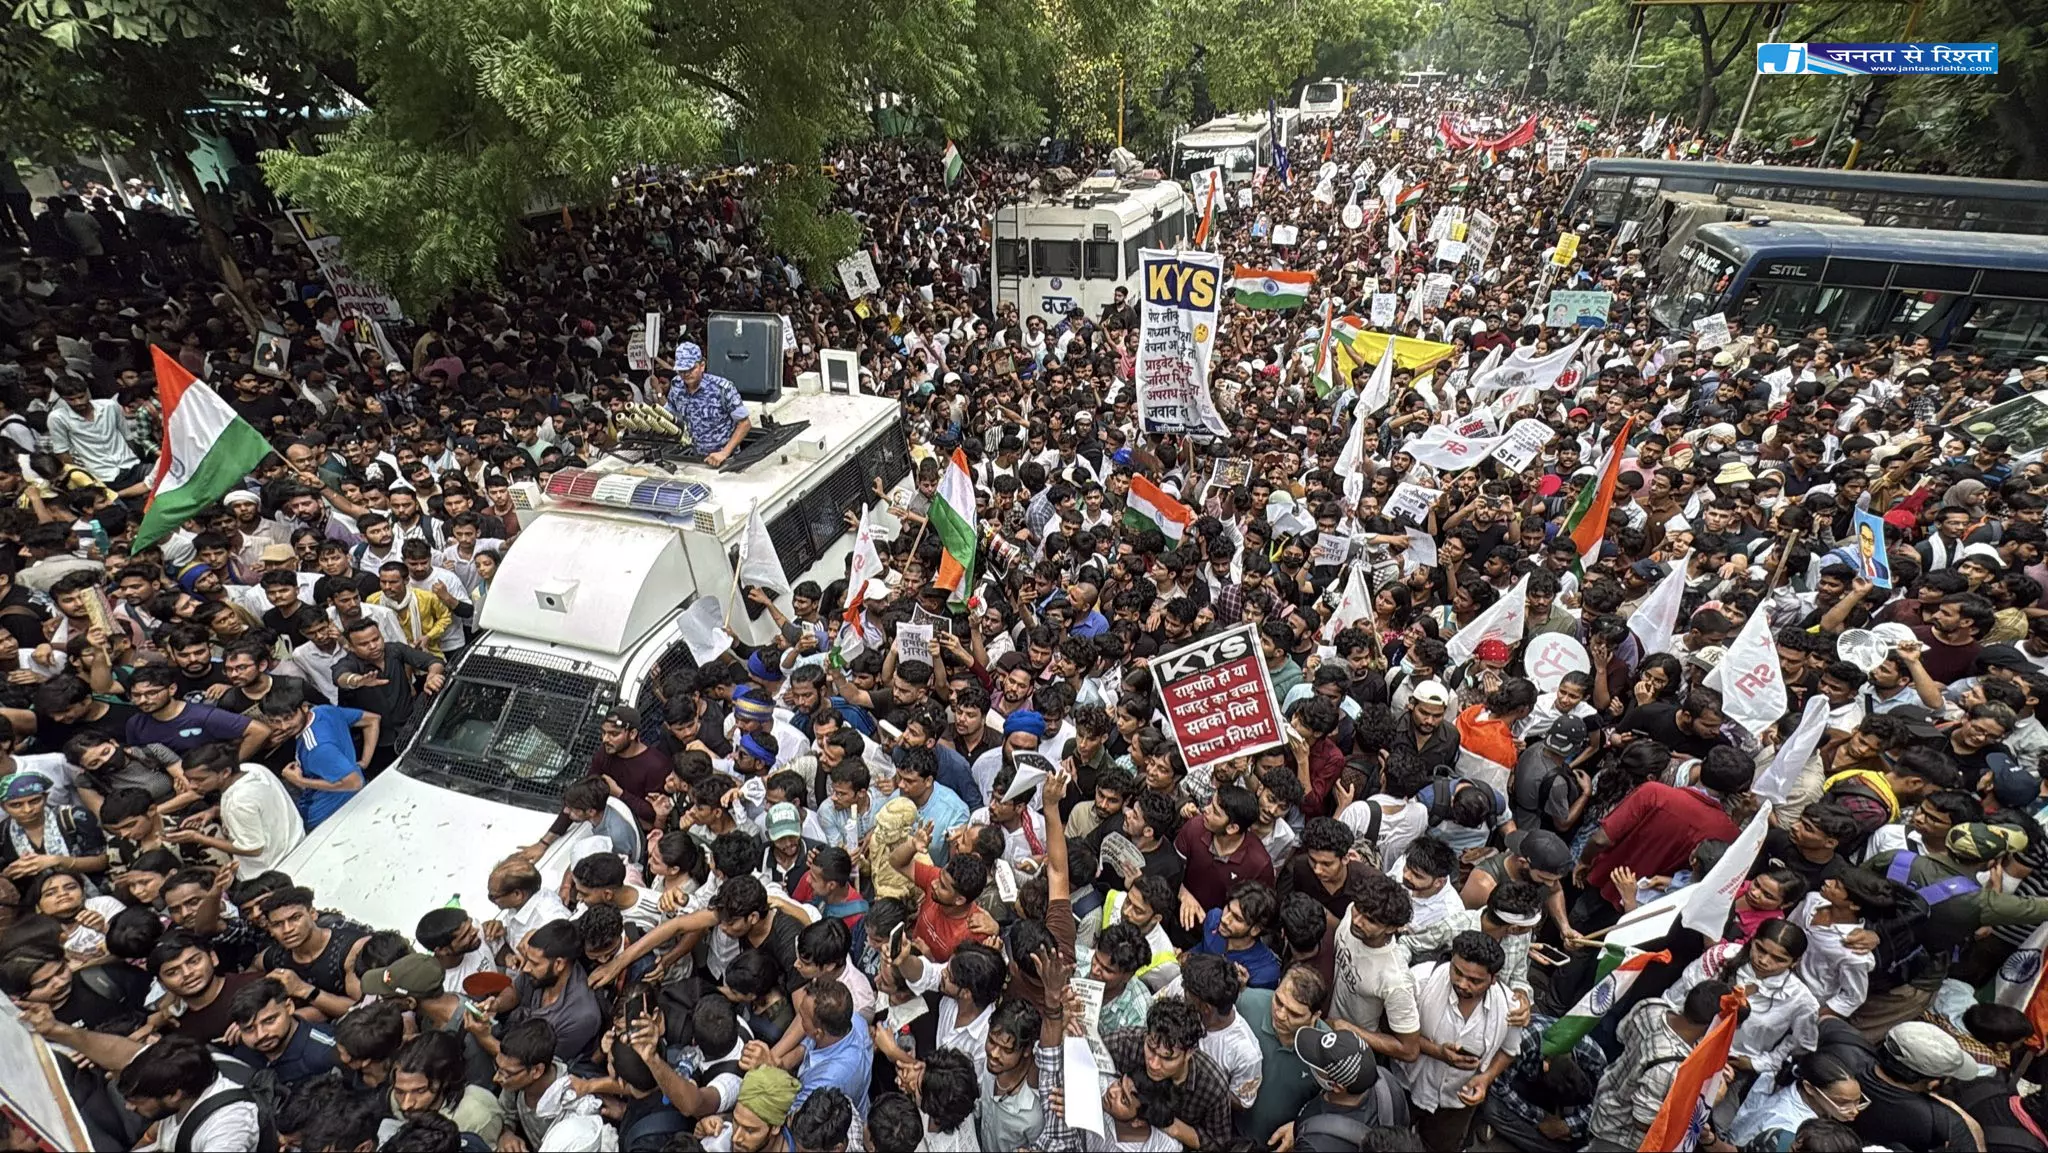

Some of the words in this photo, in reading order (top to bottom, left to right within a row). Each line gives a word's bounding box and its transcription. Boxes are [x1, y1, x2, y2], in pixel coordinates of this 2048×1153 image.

[1694, 250, 1721, 275] POLICE
[1769, 264, 1807, 277] SML
[1149, 264, 1215, 308] KYS
[1145, 355, 1174, 371] प्राइवेट
[1147, 389, 1178, 401] अपराध
[1459, 418, 1486, 436] CRORE
[1497, 448, 1521, 467] SFI
[1161, 636, 1247, 682] KYS
[1173, 675, 1216, 698] राष्ट्रपति
[1217, 668, 1231, 686] हो
[1231, 664, 1248, 677] या
[1173, 697, 1210, 716] मजदूर
[1210, 691, 1228, 704] का
[1229, 680, 1259, 698] बच्चा
[1184, 708, 1227, 736] सबको
[1227, 697, 1259, 720] मिले
[1184, 735, 1226, 758] समान
[1226, 718, 1272, 745] शिक्षा!
